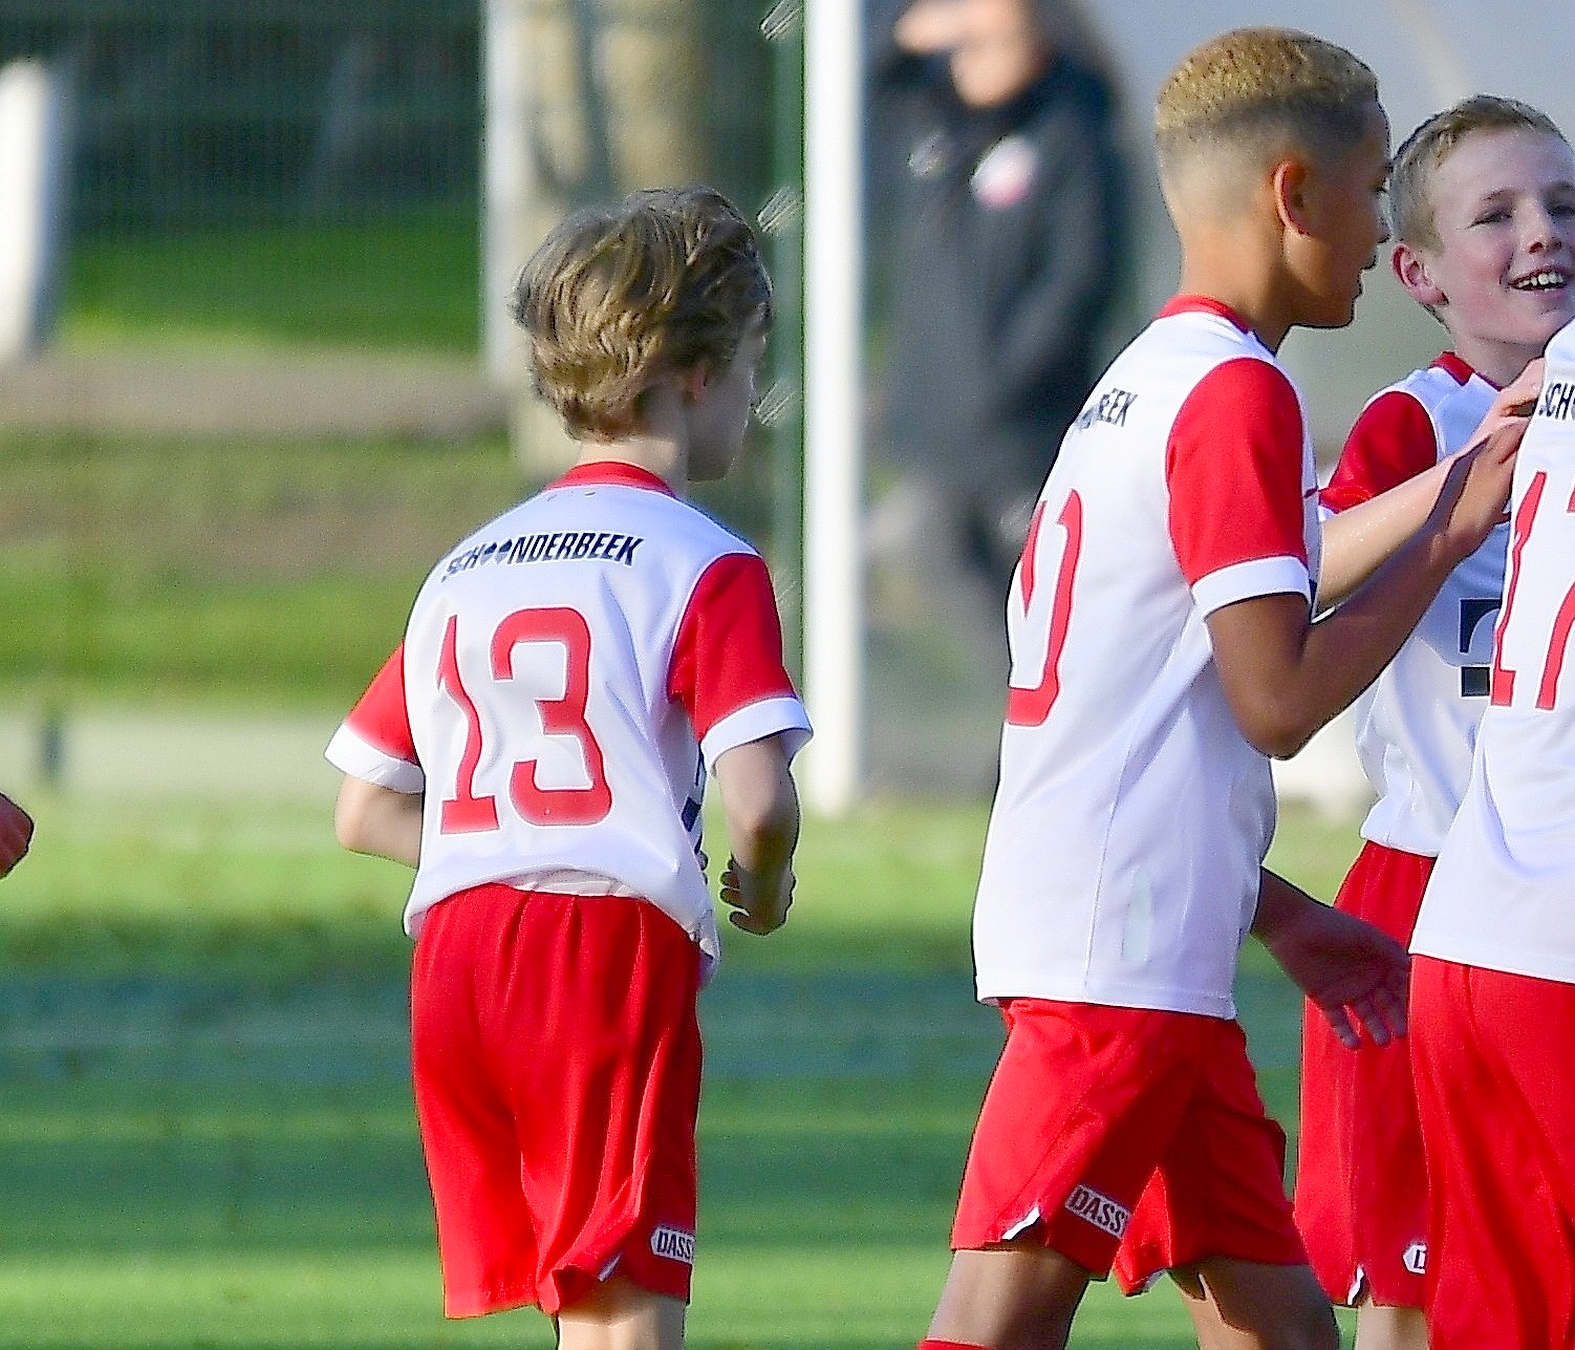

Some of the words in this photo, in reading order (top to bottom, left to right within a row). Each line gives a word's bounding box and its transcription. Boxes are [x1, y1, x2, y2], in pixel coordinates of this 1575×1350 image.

[438, 606, 613, 835] 13
[1067, 1188, 1128, 1234] DASS
[656, 1230, 694, 1260] DASS
